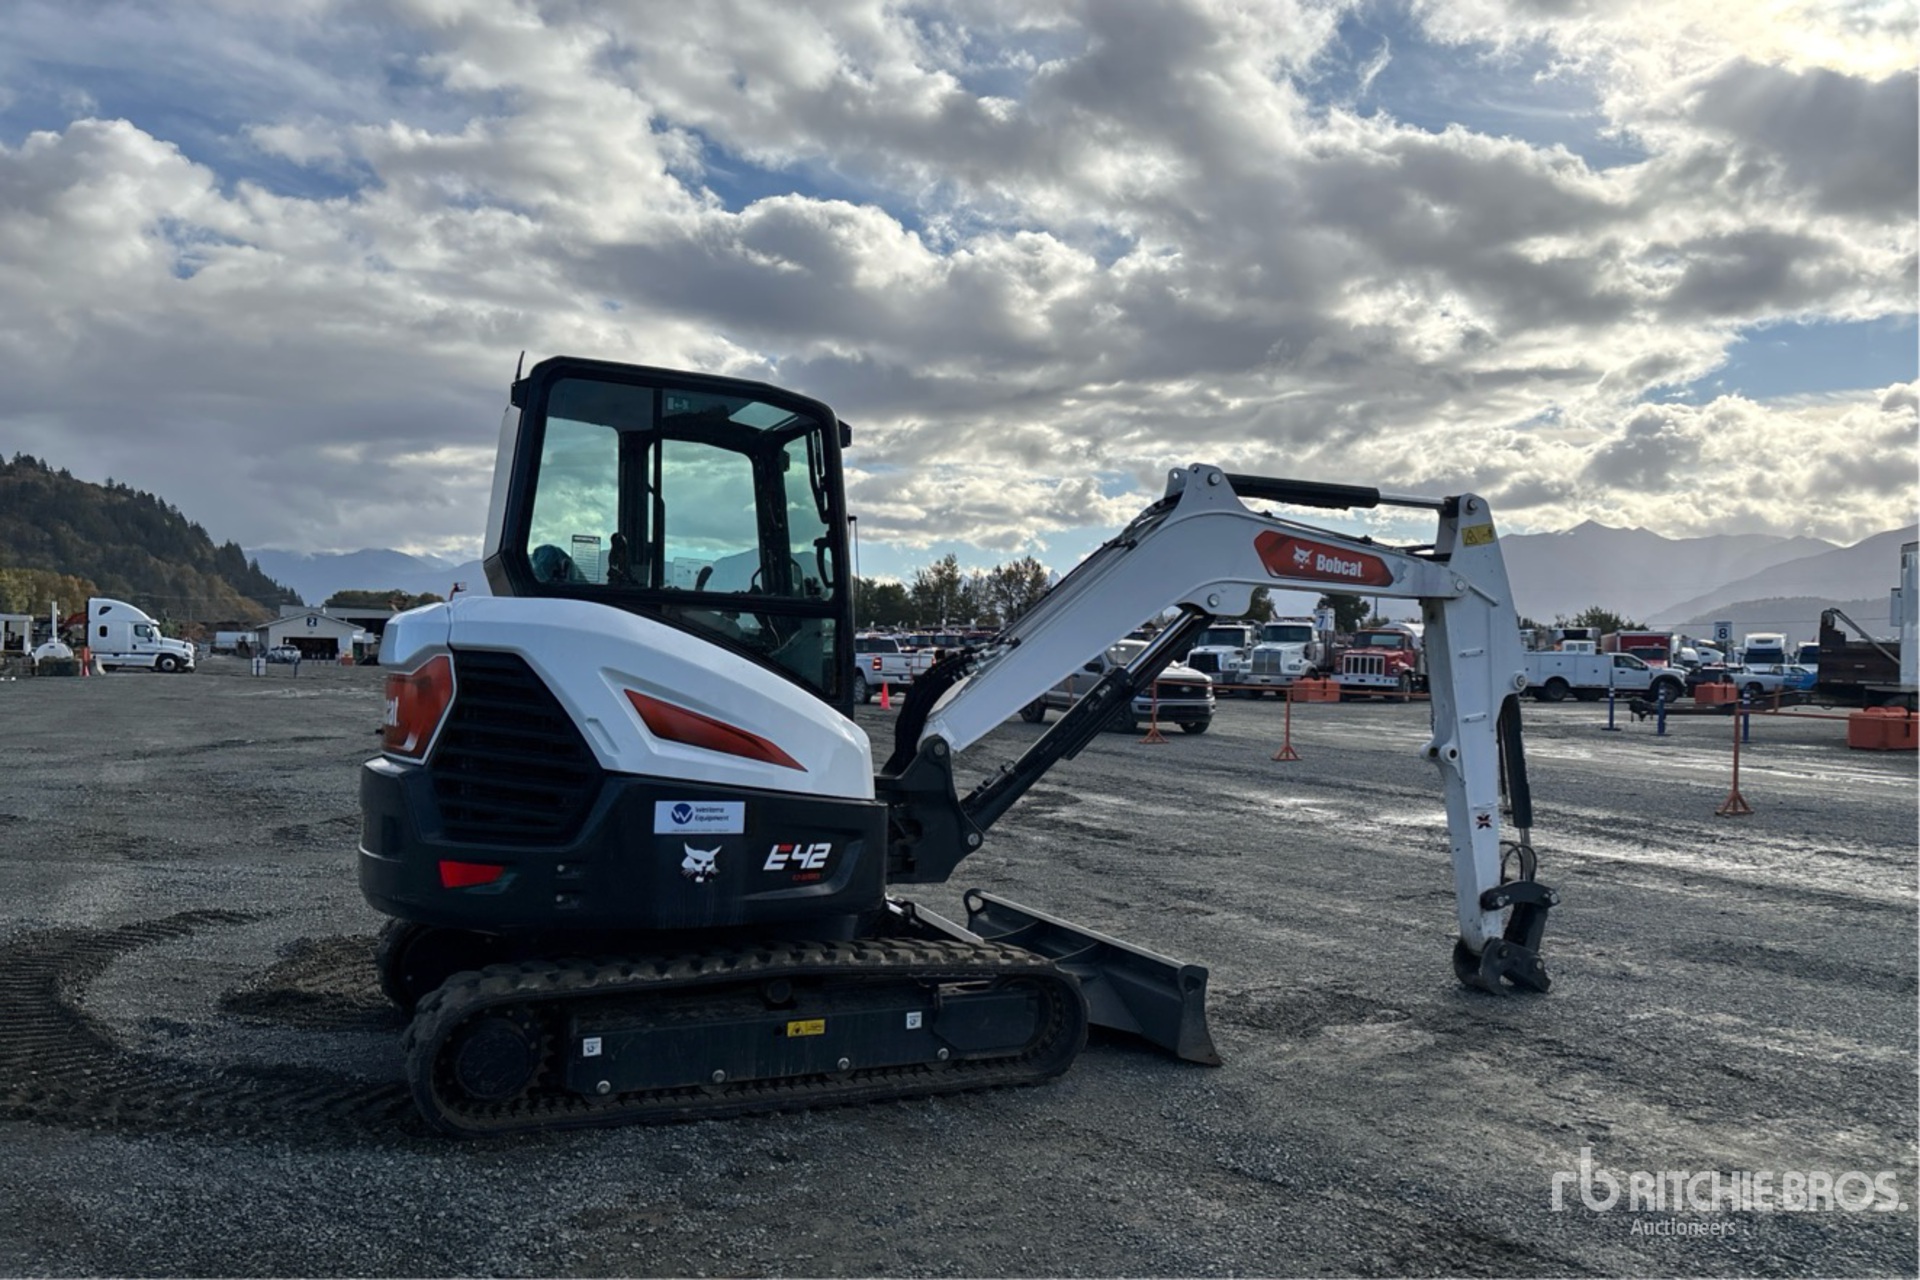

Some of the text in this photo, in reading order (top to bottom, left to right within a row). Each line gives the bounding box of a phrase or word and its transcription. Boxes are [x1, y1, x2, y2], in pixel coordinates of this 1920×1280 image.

[1316, 554, 1363, 577] Bobcat
[1318, 615, 1325, 628] 7
[1718, 628, 1728, 639] 8
[763, 843, 831, 870] E42
